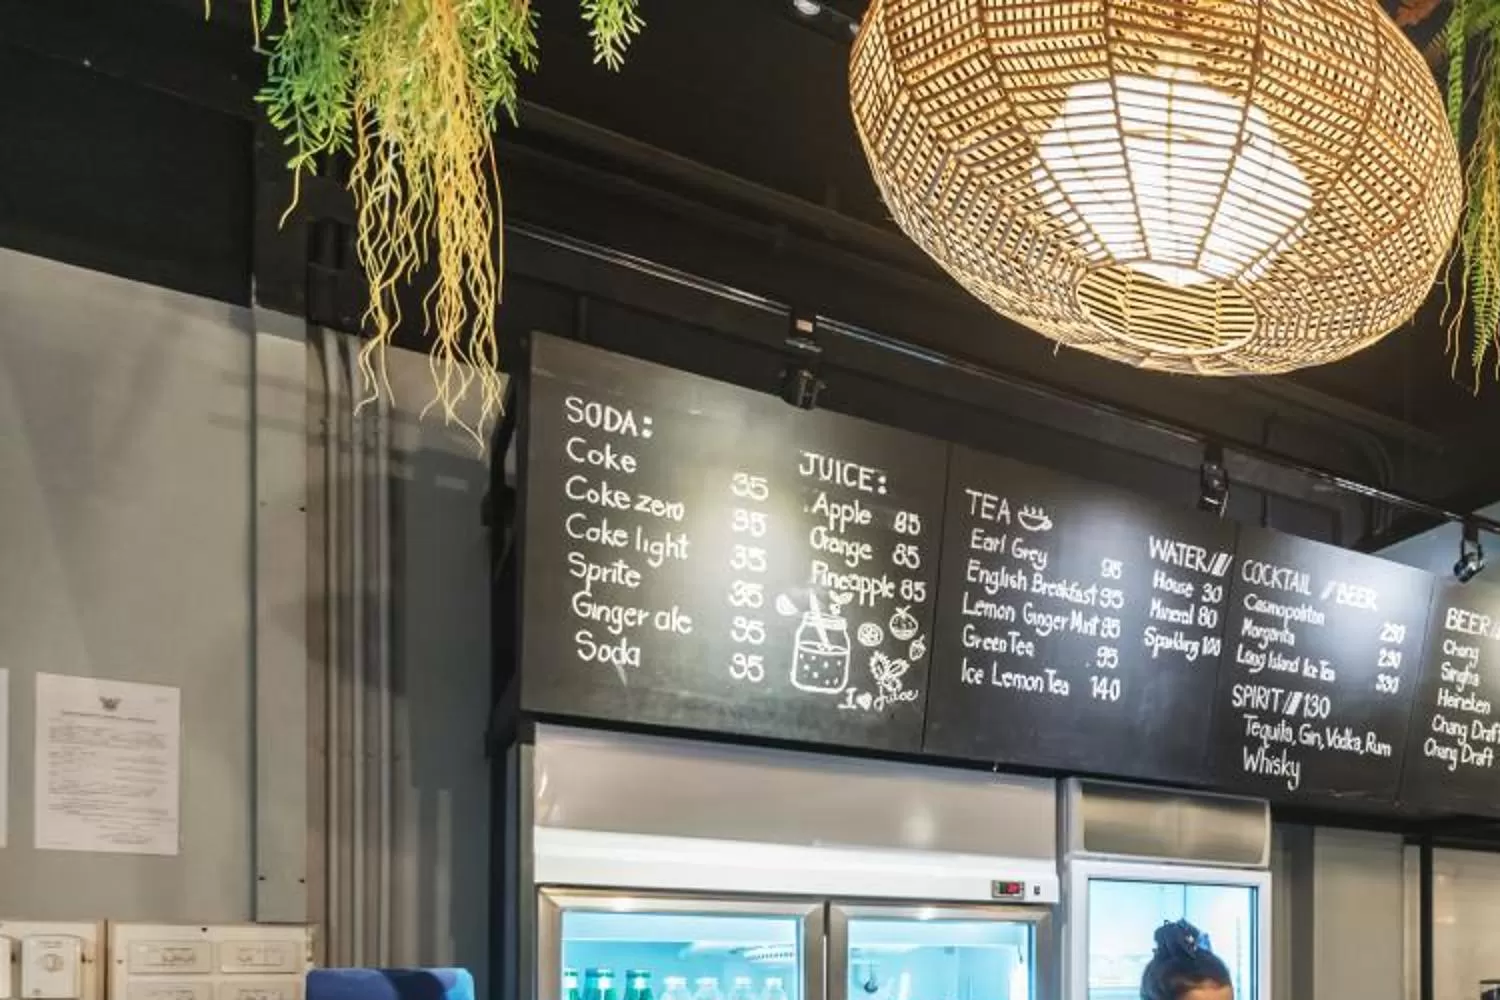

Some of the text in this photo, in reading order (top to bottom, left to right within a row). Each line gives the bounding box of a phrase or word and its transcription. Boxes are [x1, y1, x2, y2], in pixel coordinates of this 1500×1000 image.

[565, 396, 653, 438] SODA:
[566, 437, 637, 474] Coke
[799, 451, 887, 495] JUICE:
[565, 476, 685, 522] Coke zero
[730, 472, 769, 502] 35
[731, 508, 768, 537] 35
[811, 491, 873, 533] Apple
[965, 488, 1011, 525] TEA
[565, 513, 690, 568] Coke light
[809, 526, 873, 567] Orange
[971, 528, 1048, 571] Earl Grey
[567, 551, 641, 590] Sprite
[730, 545, 768, 573] 35
[811, 560, 895, 606] Pineapple
[967, 559, 1027, 595] English
[1031, 573, 1098, 607] Breakfast
[1153, 569, 1222, 604] House 30
[1241, 560, 1312, 596] COCKTAIL
[572, 588, 693, 635] Ginger ale
[962, 592, 1015, 623] Lemon
[1023, 601, 1067, 637] Ginger
[1070, 609, 1100, 637] Mint
[1150, 598, 1217, 629] Mineral 80
[1244, 594, 1325, 628] Cosmopolitan
[730, 616, 765, 645] 35
[963, 624, 1035, 658] Green Tea
[1144, 626, 1200, 661] Sparkling
[1242, 617, 1295, 650] Margarita
[575, 631, 640, 667] Soda
[1236, 644, 1336, 682] Long Island Ice Tea
[1443, 640, 1480, 668] Chang
[729, 654, 764, 683] 35
[961, 658, 1121, 702] Ice Lemon Tea 140
[1441, 661, 1480, 692] Singha
[1303, 694, 1331, 718] 130
[1244, 714, 1392, 757] Tequila, Gin, Vodka, Rum
[1432, 714, 1469, 746] Chang
[1243, 747, 1301, 791] Whisky
[1424, 737, 1458, 772] Chang
[1461, 744, 1494, 768] Draft
